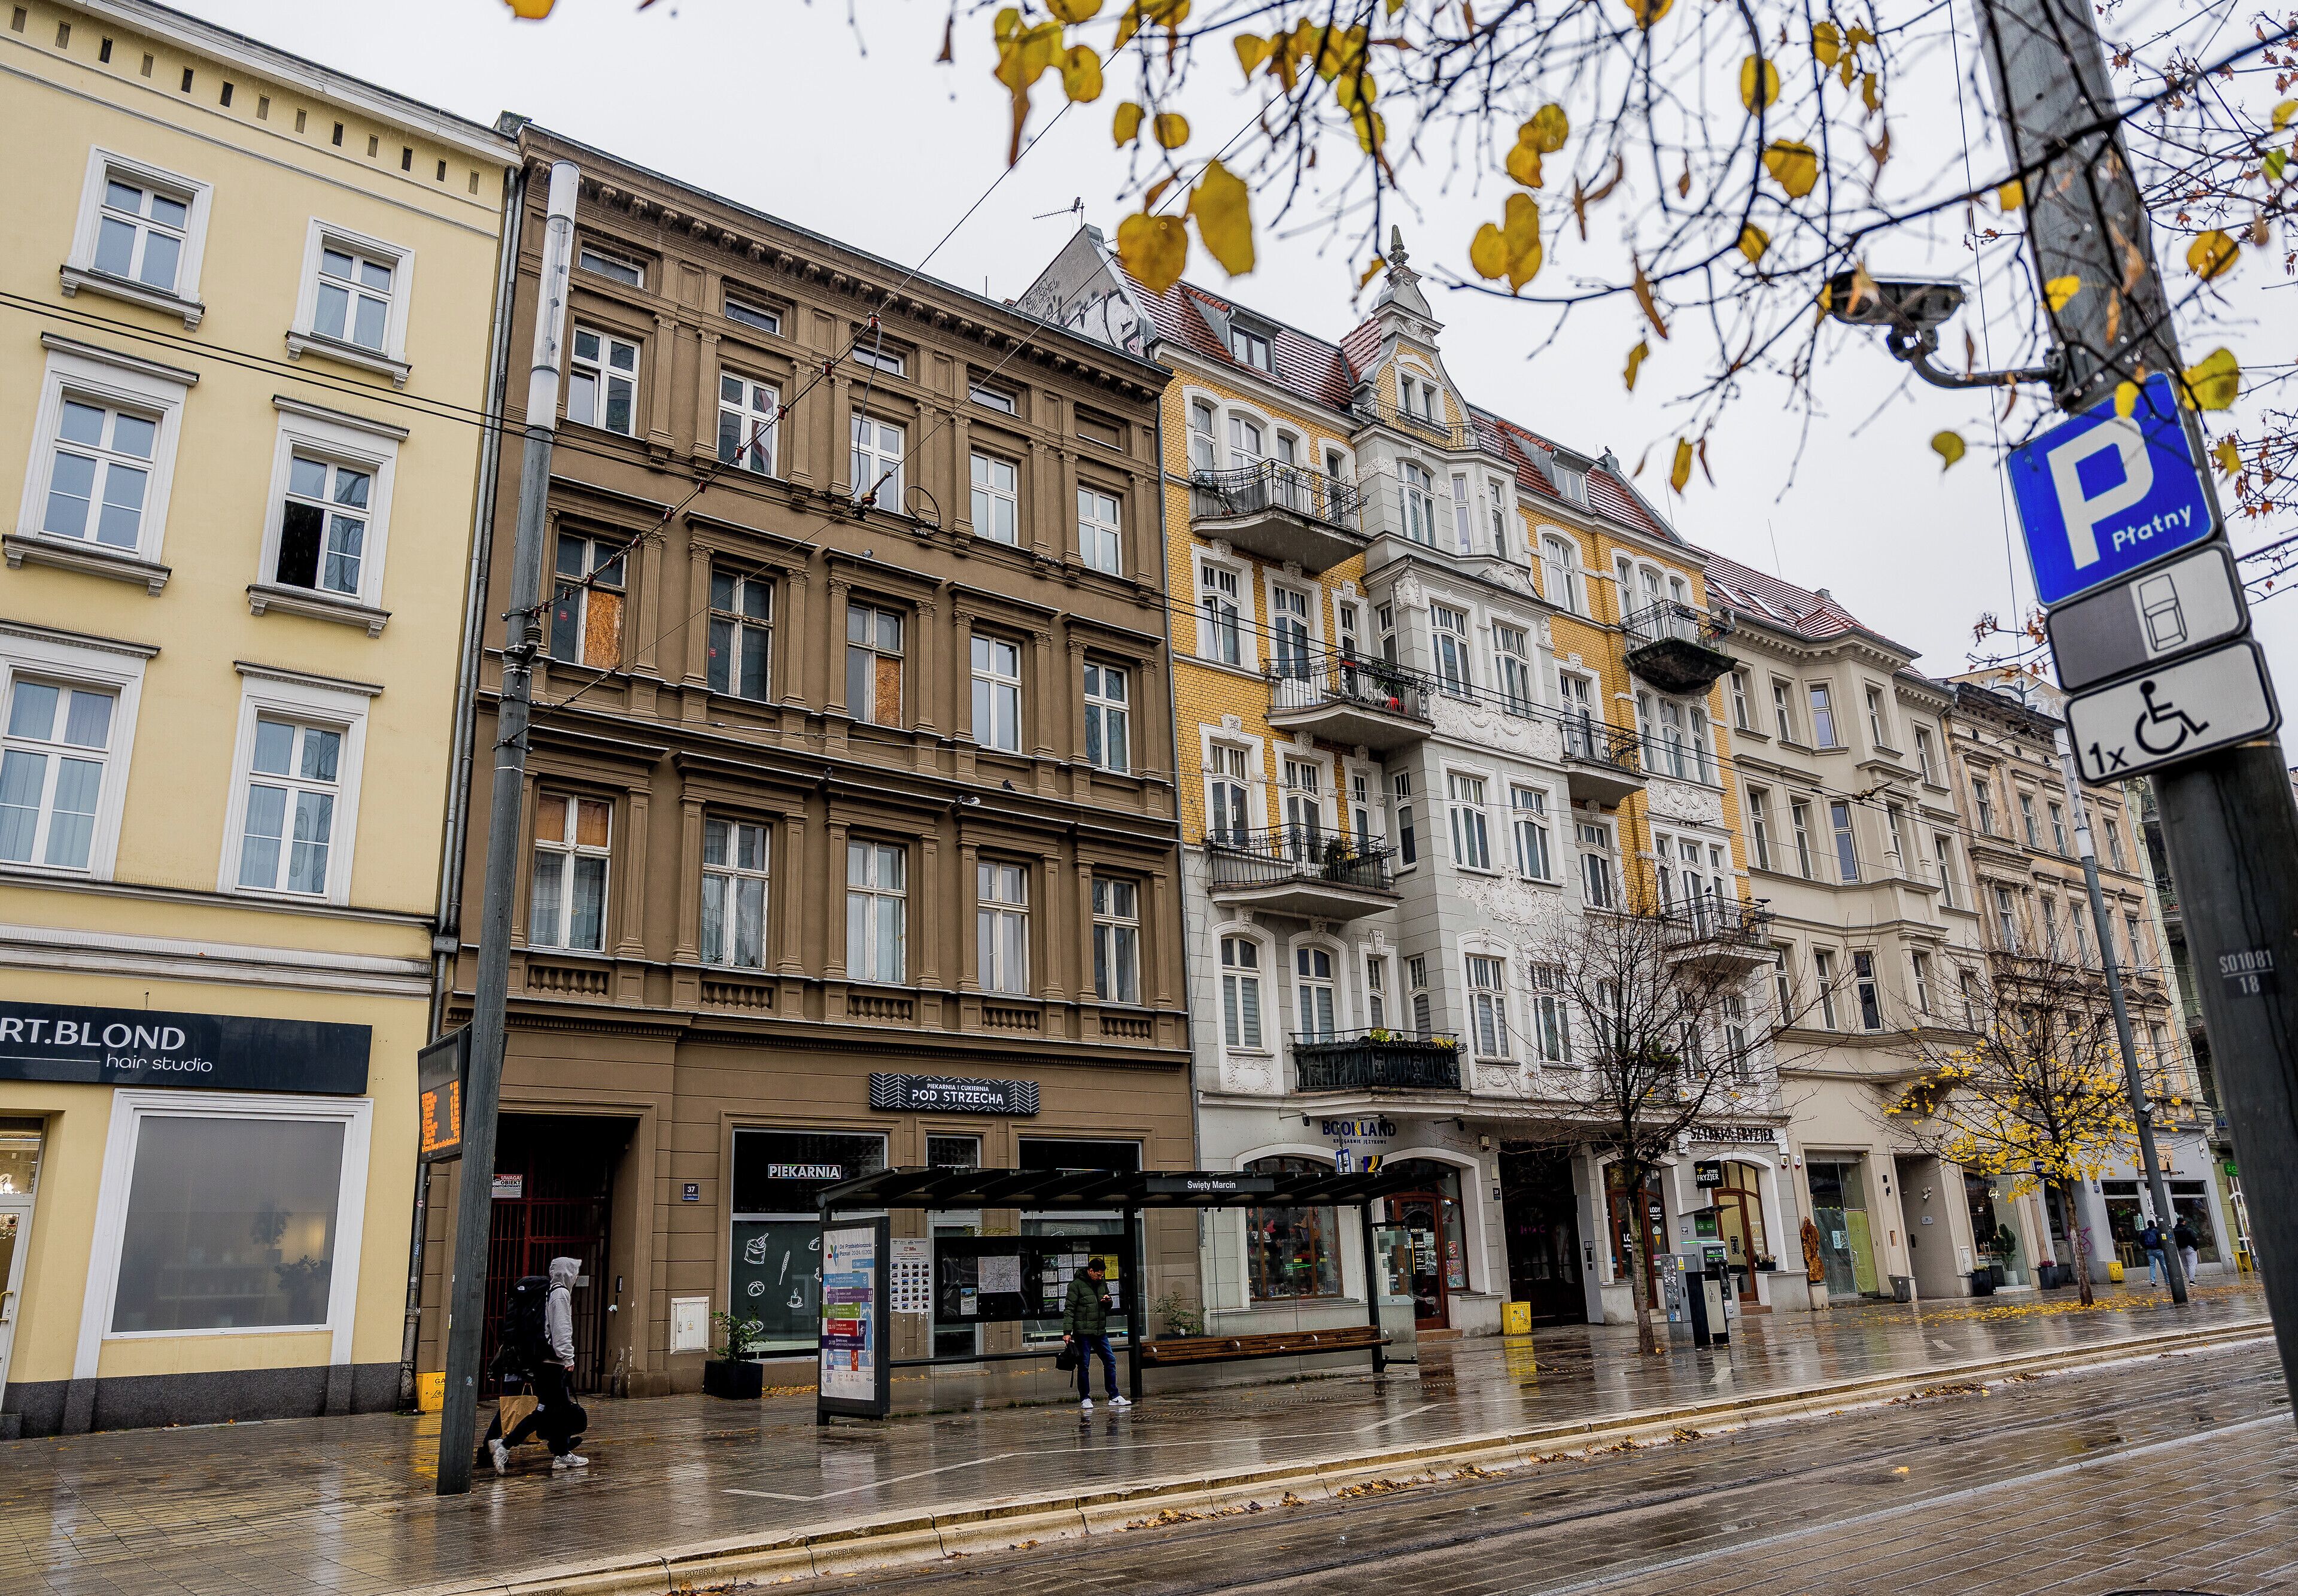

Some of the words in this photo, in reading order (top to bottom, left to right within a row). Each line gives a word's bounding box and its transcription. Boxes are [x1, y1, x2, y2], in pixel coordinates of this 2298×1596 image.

[2047, 416, 2154, 570] P
[2112, 504, 2191, 553] Płatny
[2089, 741, 2130, 774] 1x
[2240, 975, 2260, 993] 18
[106, 1054, 147, 1069] hair
[152, 1057, 212, 1072] studio
[912, 1090, 937, 1101] POD
[1321, 1120, 1396, 1136] BOOKLAND
[1737, 1127, 1775, 1142] FRYZJER
[770, 1166, 840, 1178] PIEKARNIA
[1187, 1180, 1211, 1191] Święty
